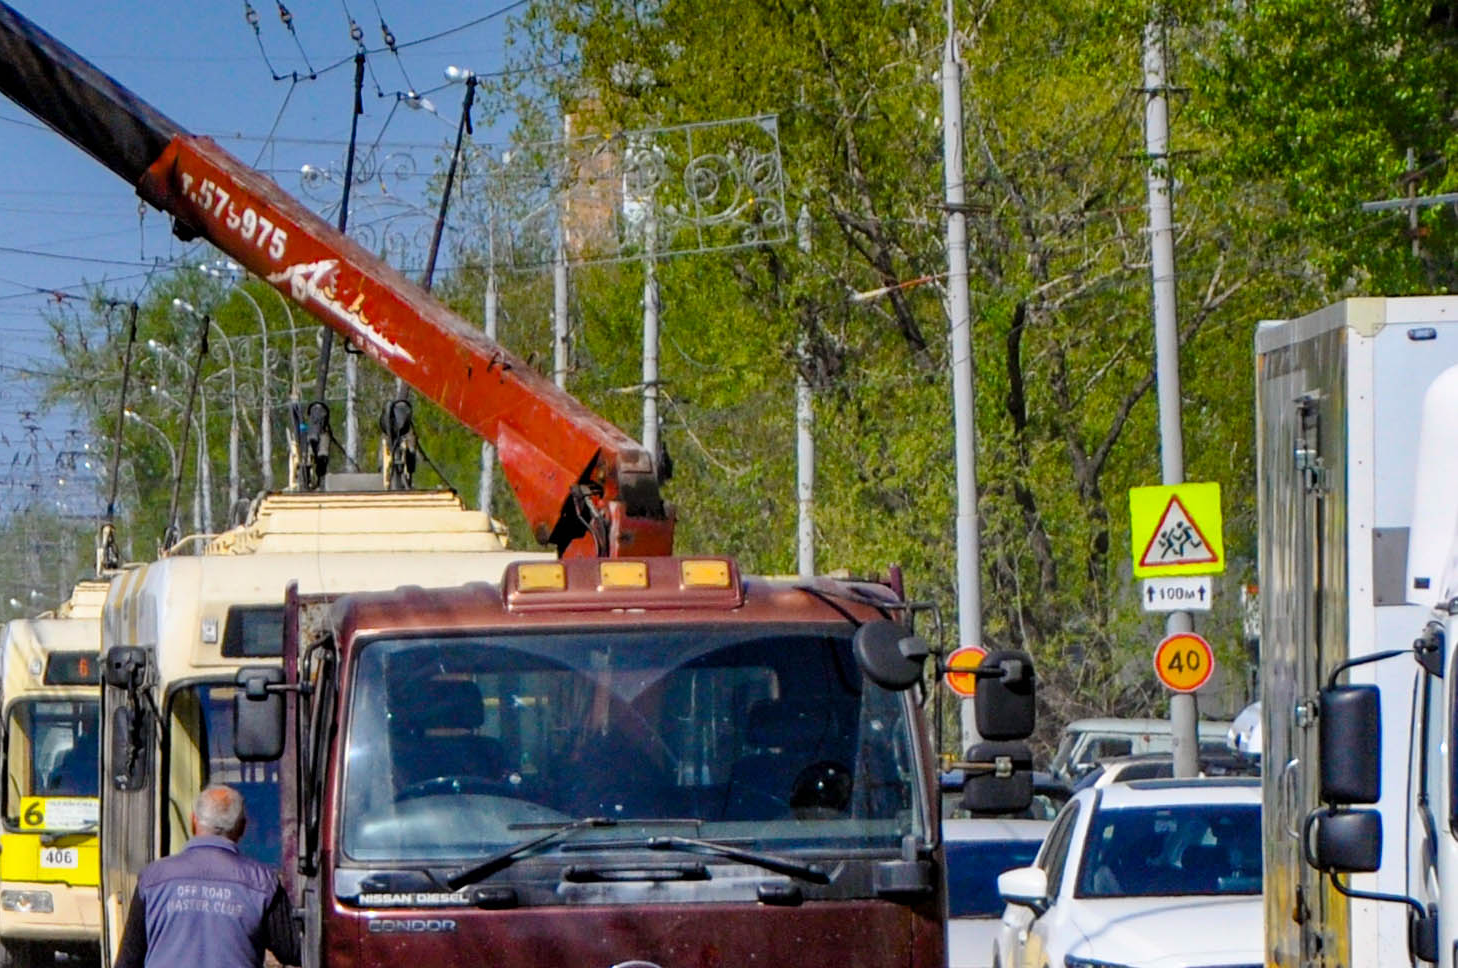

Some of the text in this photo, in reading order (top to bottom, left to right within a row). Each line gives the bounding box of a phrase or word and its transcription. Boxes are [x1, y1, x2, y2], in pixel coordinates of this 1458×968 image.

[1159, 587, 1196, 600] 100м
[1167, 649, 1201, 674] 40
[24, 801, 44, 826] 6
[45, 850, 73, 864] 406
[359, 892, 470, 904] NISSAN DIESEL
[368, 919, 457, 933] CONDOR
